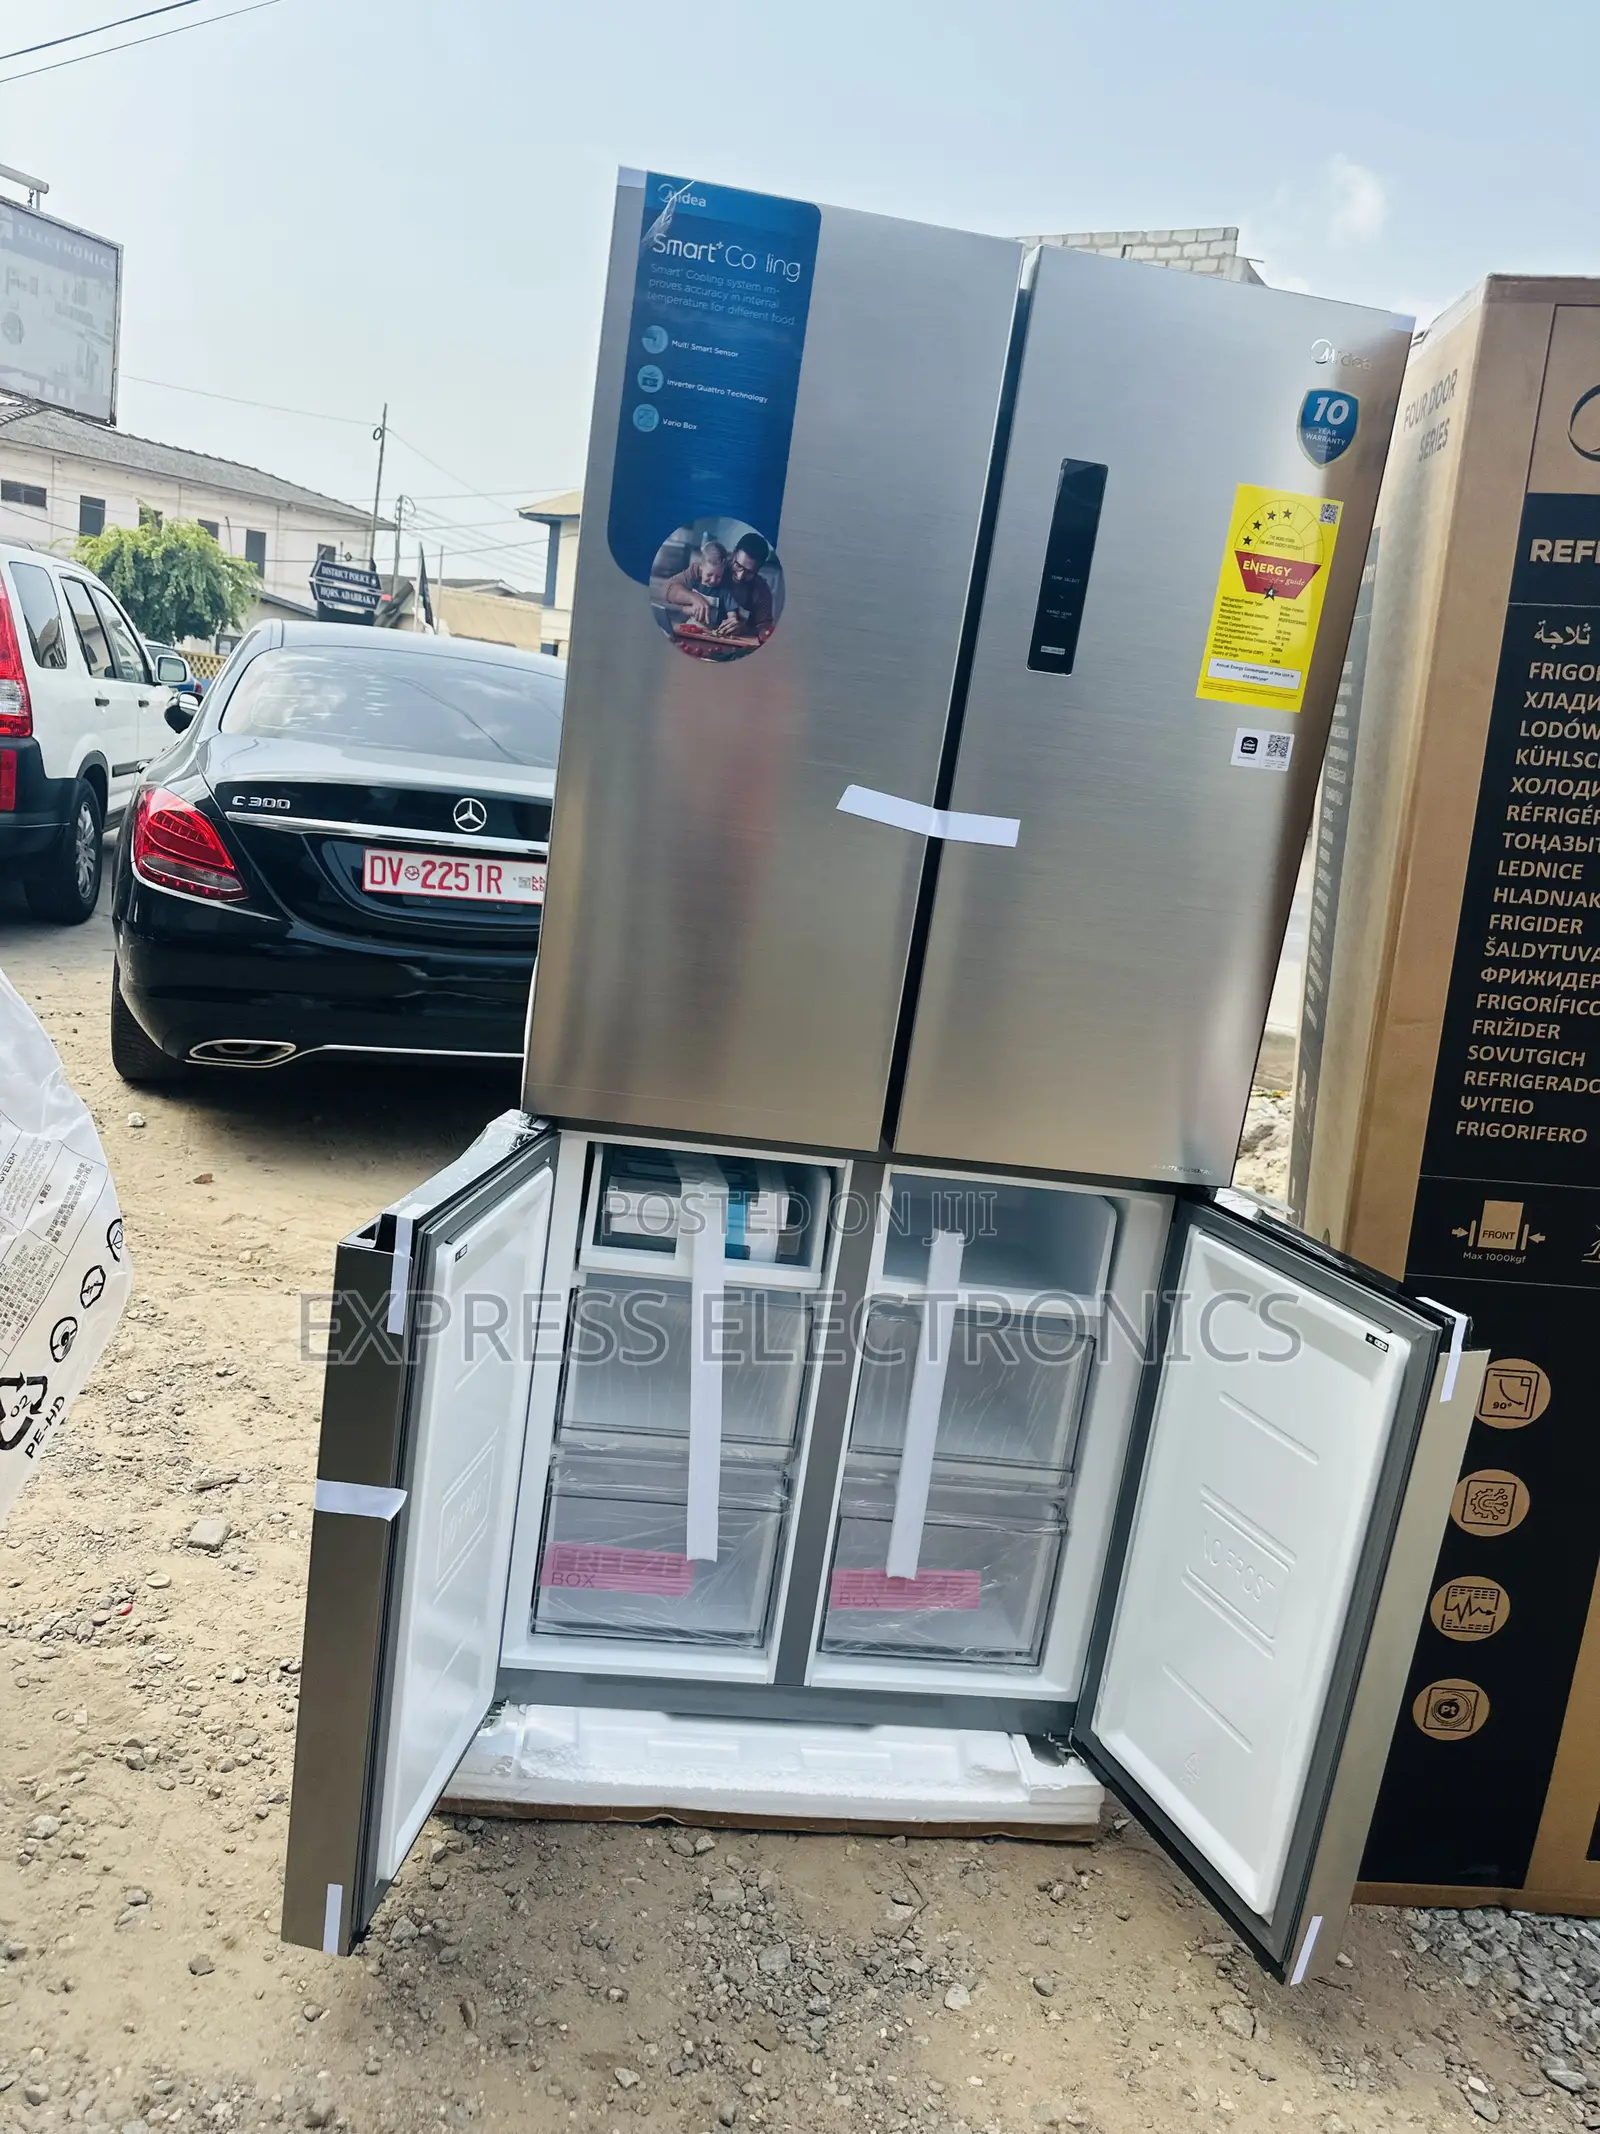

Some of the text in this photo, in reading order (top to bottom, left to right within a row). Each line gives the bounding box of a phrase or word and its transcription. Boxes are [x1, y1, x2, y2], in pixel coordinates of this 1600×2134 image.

[657, 183, 707, 207] Midea
[686, 269, 724, 287] Cooling
[726, 278, 761, 292] system
[649, 278, 780, 309] proves accuracy in internal
[648, 292, 709, 310] temperature
[711, 301, 725, 312] for
[727, 305, 768, 321] different
[691, 343, 713, 354] Smart
[714, 346, 740, 358] Sensor
[667, 378, 769, 404] Inverter Quattro Technology
[1403, 368, 1459, 433] FOUR DOOR
[1313, 396, 1350, 426] 10
[662, 418, 698, 431] Vario Box
[1317, 427, 1337, 437] YEAR
[1305, 433, 1346, 446] WARRANTY
[1418, 417, 1451, 463] SERIES
[1529, 538, 1600, 564] REF
[348, 572, 370, 584] POLICE
[1242, 558, 1292, 577] ENERGY
[1534, 620, 1591, 649] ثلاجة
[1523, 690, 1600, 714] ХЛАДИ
[1519, 717, 1600, 741] LODÓW
[1515, 745, 1600, 769] KÜHLSC
[232, 795, 291, 810] C 300
[369, 855, 503, 894] DV 2251R
[1497, 860, 1584, 880] LEDNICE
[1493, 887, 1600, 909] HLADNJAK
[1488, 914, 1584, 935] FRIGIDER
[1483, 936, 1600, 962] ŠALDYTUVA
[1480, 966, 1600, 991] ФРИЖИДЕР
[1471, 1016, 1561, 1040] FRIŽIDER
[1467, 1044, 1586, 1067] SOVUTGICH
[1460, 1095, 1534, 1115] ΨΥΓΕΙΟ
[1455, 1120, 1588, 1144] FRIGORIFERO
[1482, 1230, 1515, 1240] FRONT
[1463, 1252, 1527, 1264] Max 1000kgf
[25, 1396, 65, 1458] PE-HD
[551, 1571, 596, 1588] BOX
[839, 1591, 880, 1607] BOX
[1441, 1704, 1457, 1716] Pt
